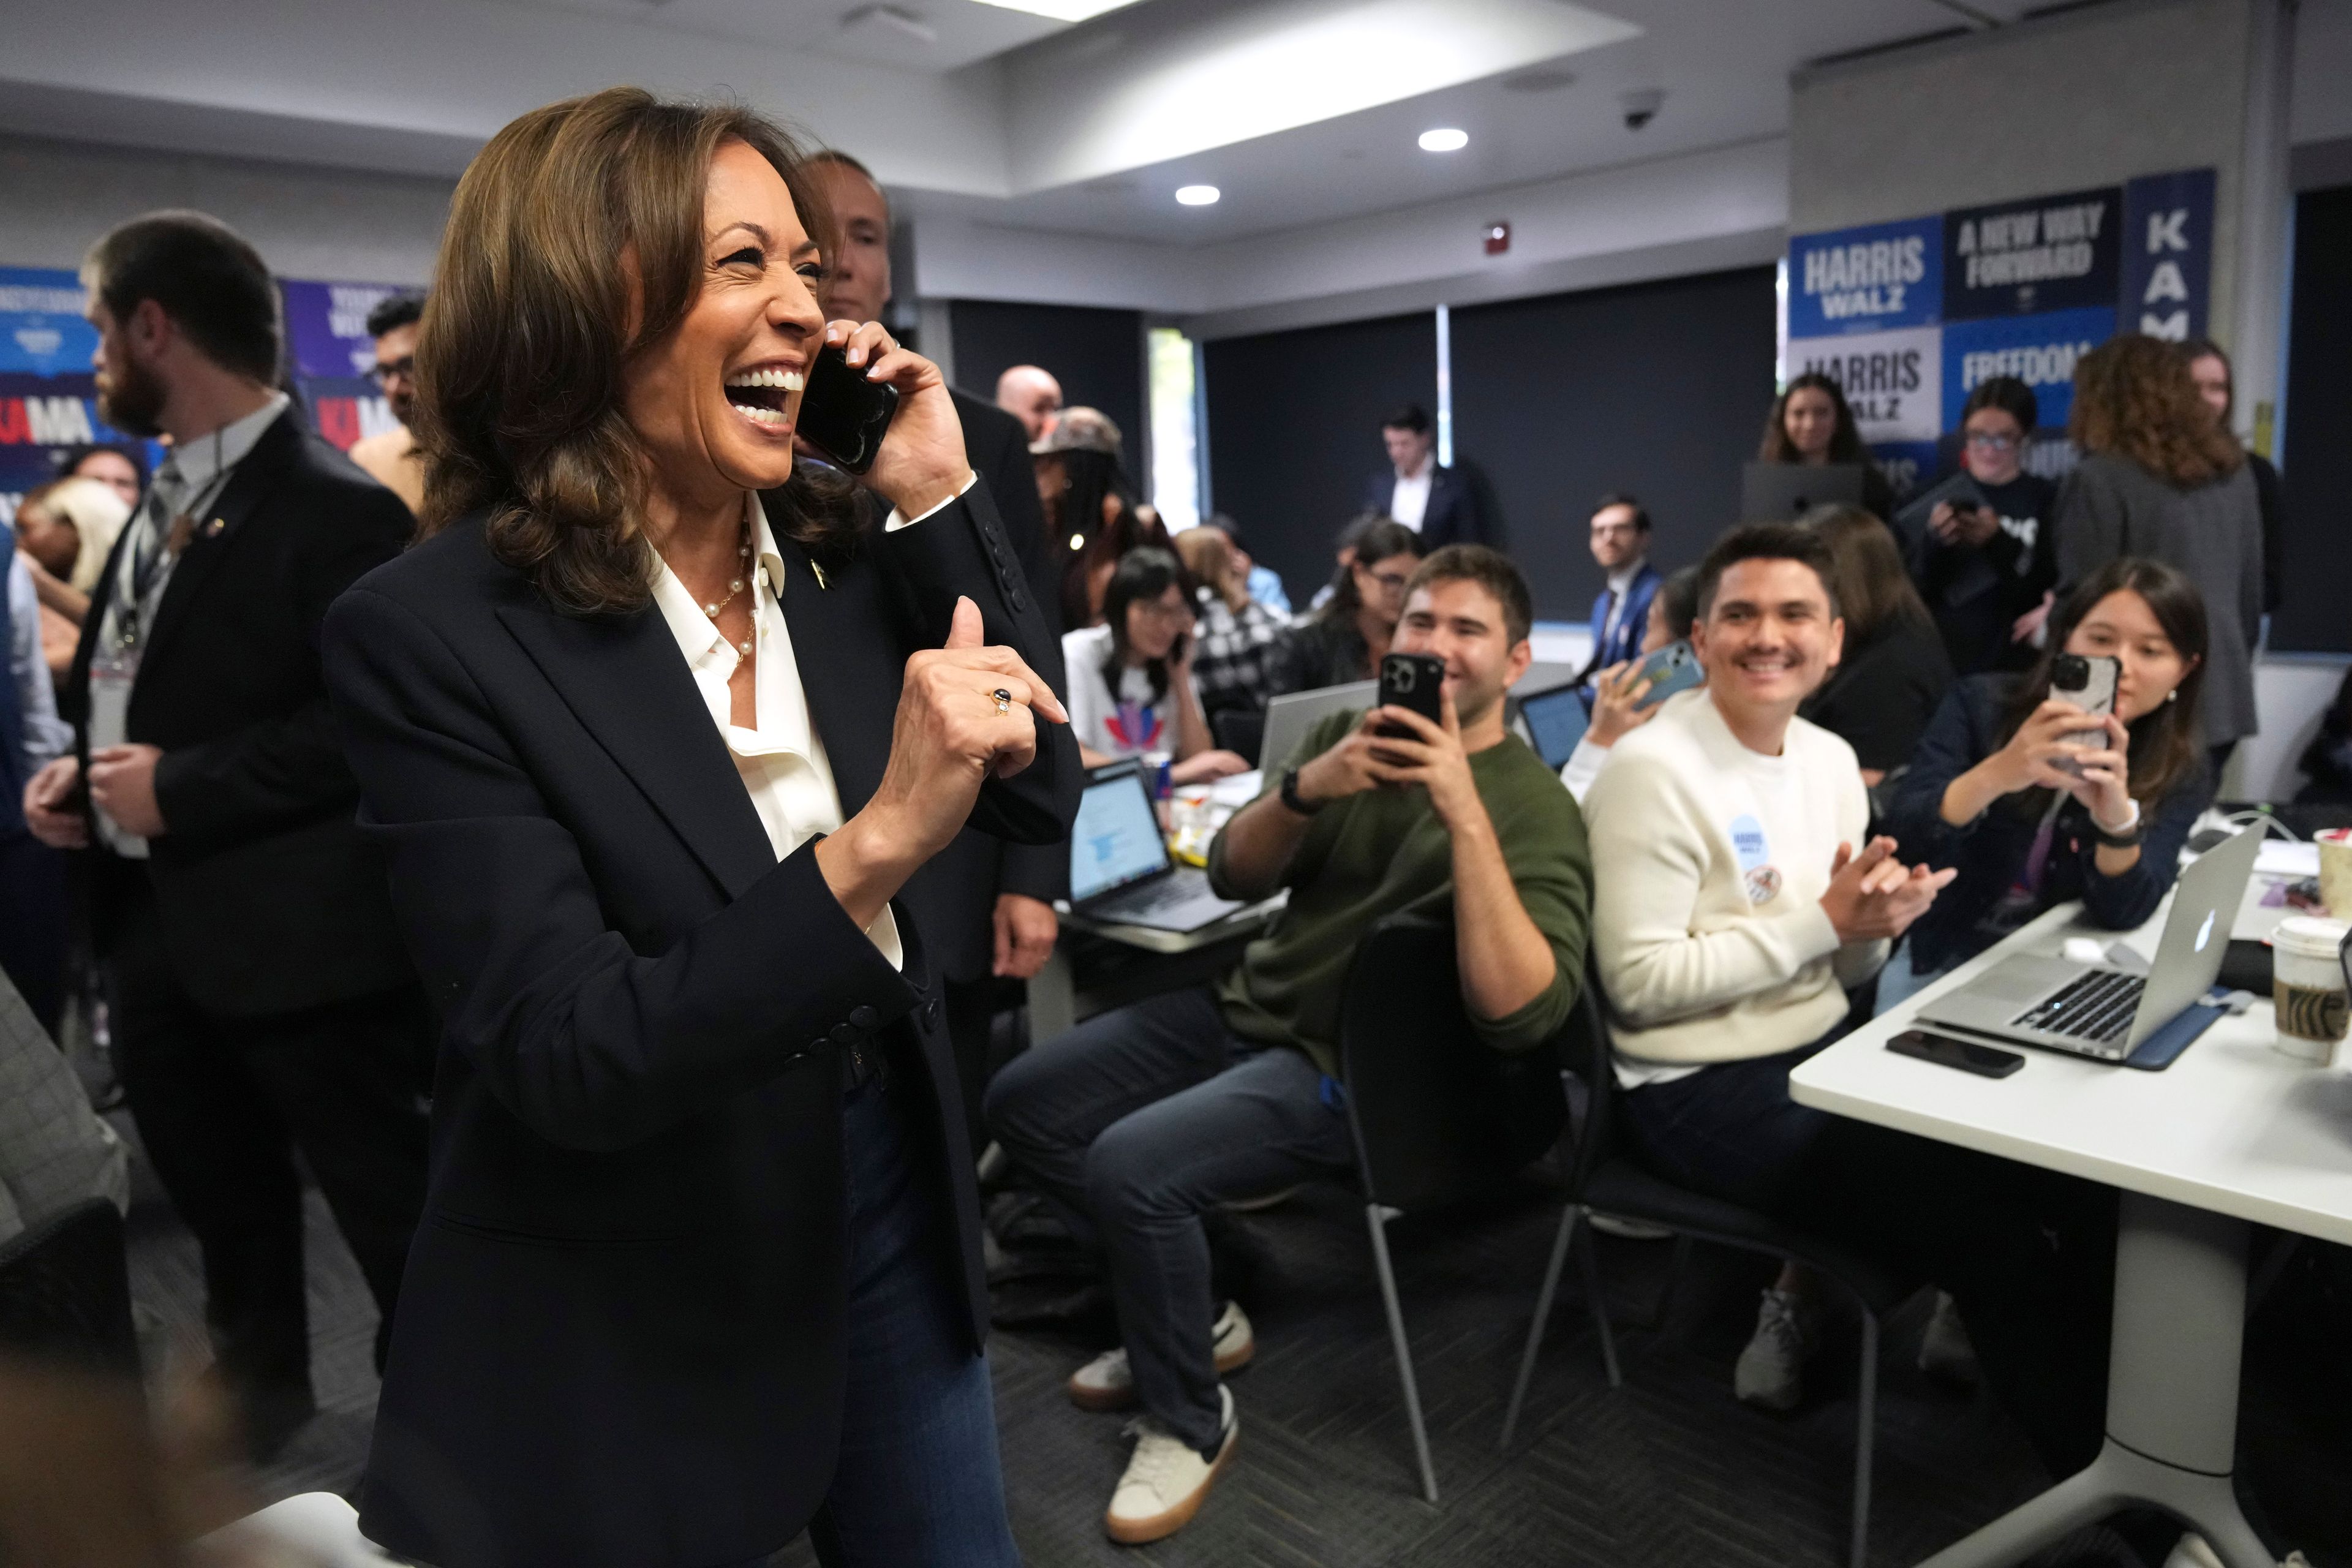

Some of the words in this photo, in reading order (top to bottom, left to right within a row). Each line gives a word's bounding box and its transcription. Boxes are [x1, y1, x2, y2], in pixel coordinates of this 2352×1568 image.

[1957, 219, 1978, 256] A
[1980, 211, 2040, 250] NEW
[2043, 200, 2106, 241] WAY
[1804, 235, 1924, 295] HARRIS
[1966, 239, 2094, 289] FORWARD
[1822, 285, 1905, 319] WALZ
